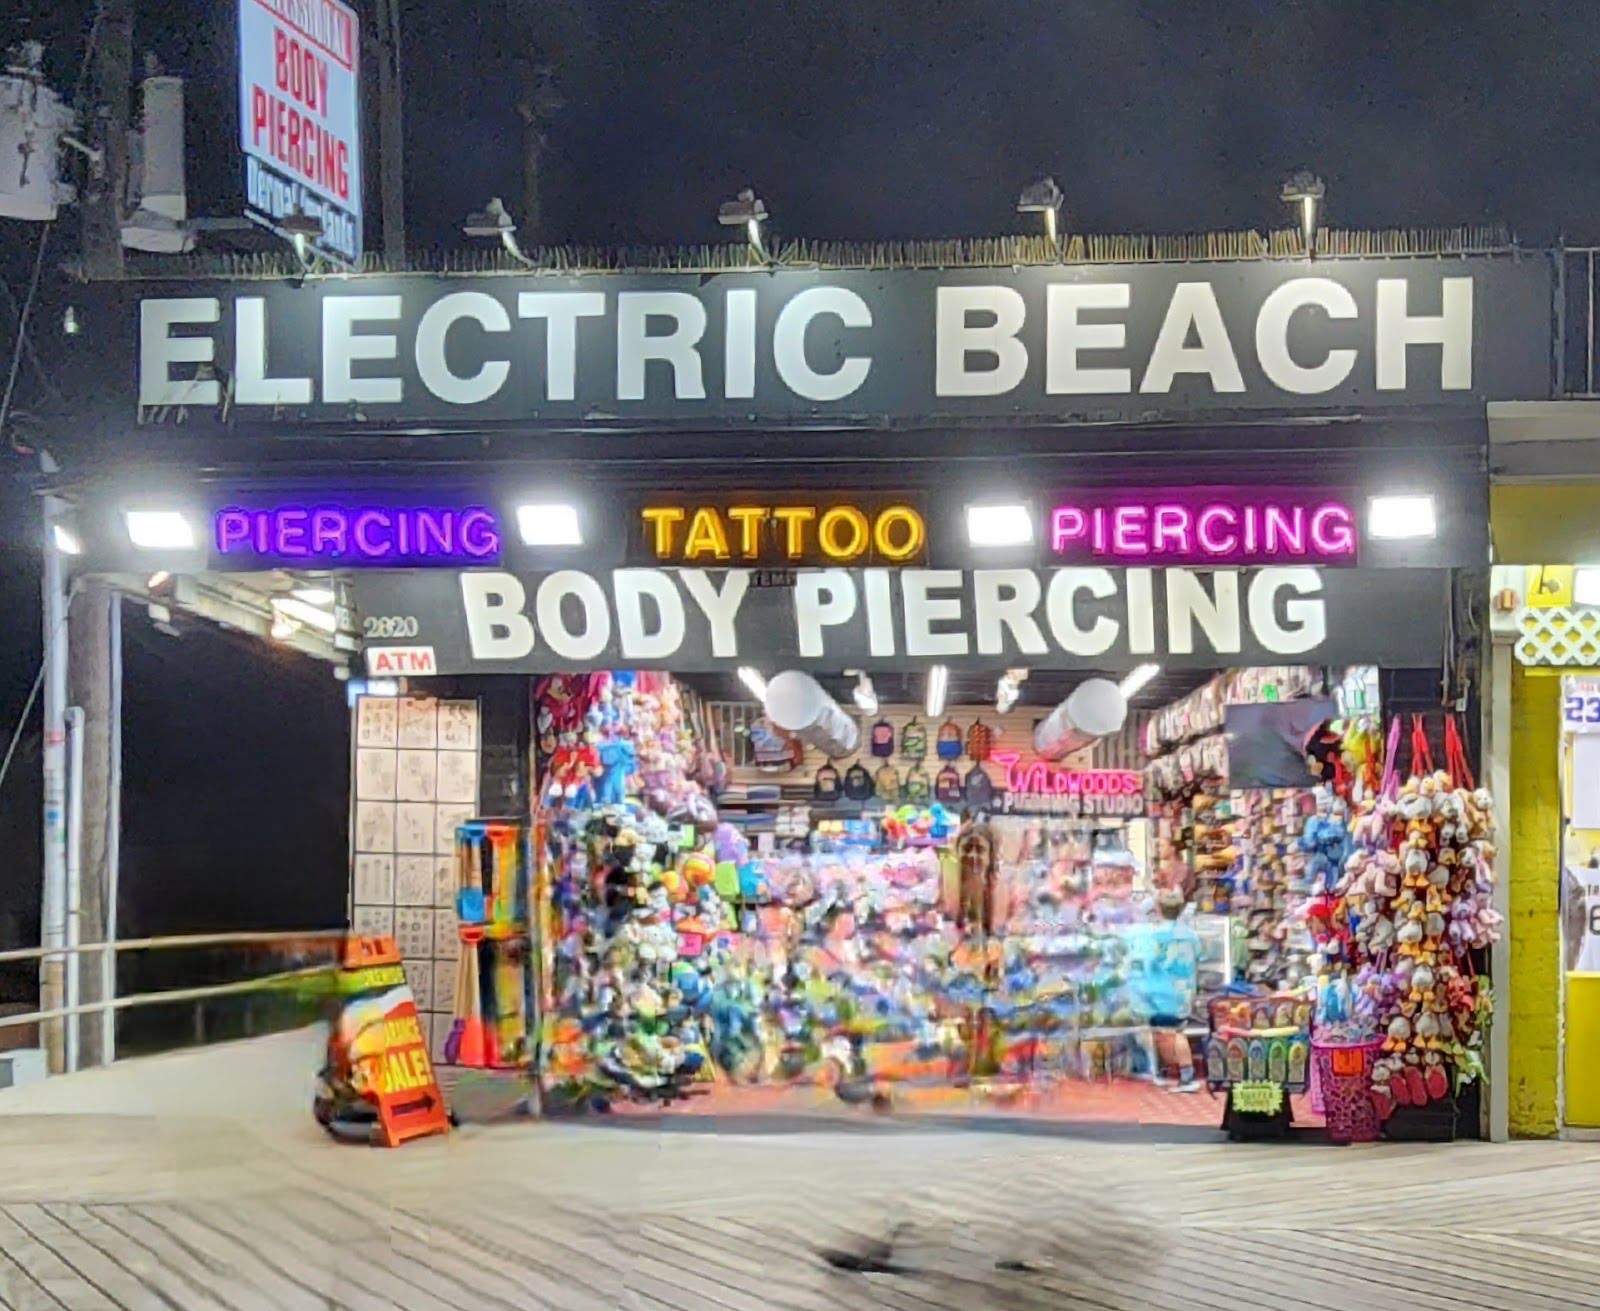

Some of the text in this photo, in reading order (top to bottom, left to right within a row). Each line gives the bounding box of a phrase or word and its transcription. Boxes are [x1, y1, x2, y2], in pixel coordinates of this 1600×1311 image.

[273, 25, 328, 118] BODY
[252, 83, 348, 200] PIERCING
[138, 277, 1473, 405] ELECTRIC BEACH
[215, 505, 499, 557] PIERCING
[641, 505, 927, 561] TATTOO
[1051, 503, 1355, 554] PIERCING
[363, 615, 419, 638] 2820
[460, 566, 1326, 661] BODY PIERCING
[376, 652, 432, 671] ATM
[1083, 794, 1144, 814] STUDIO
